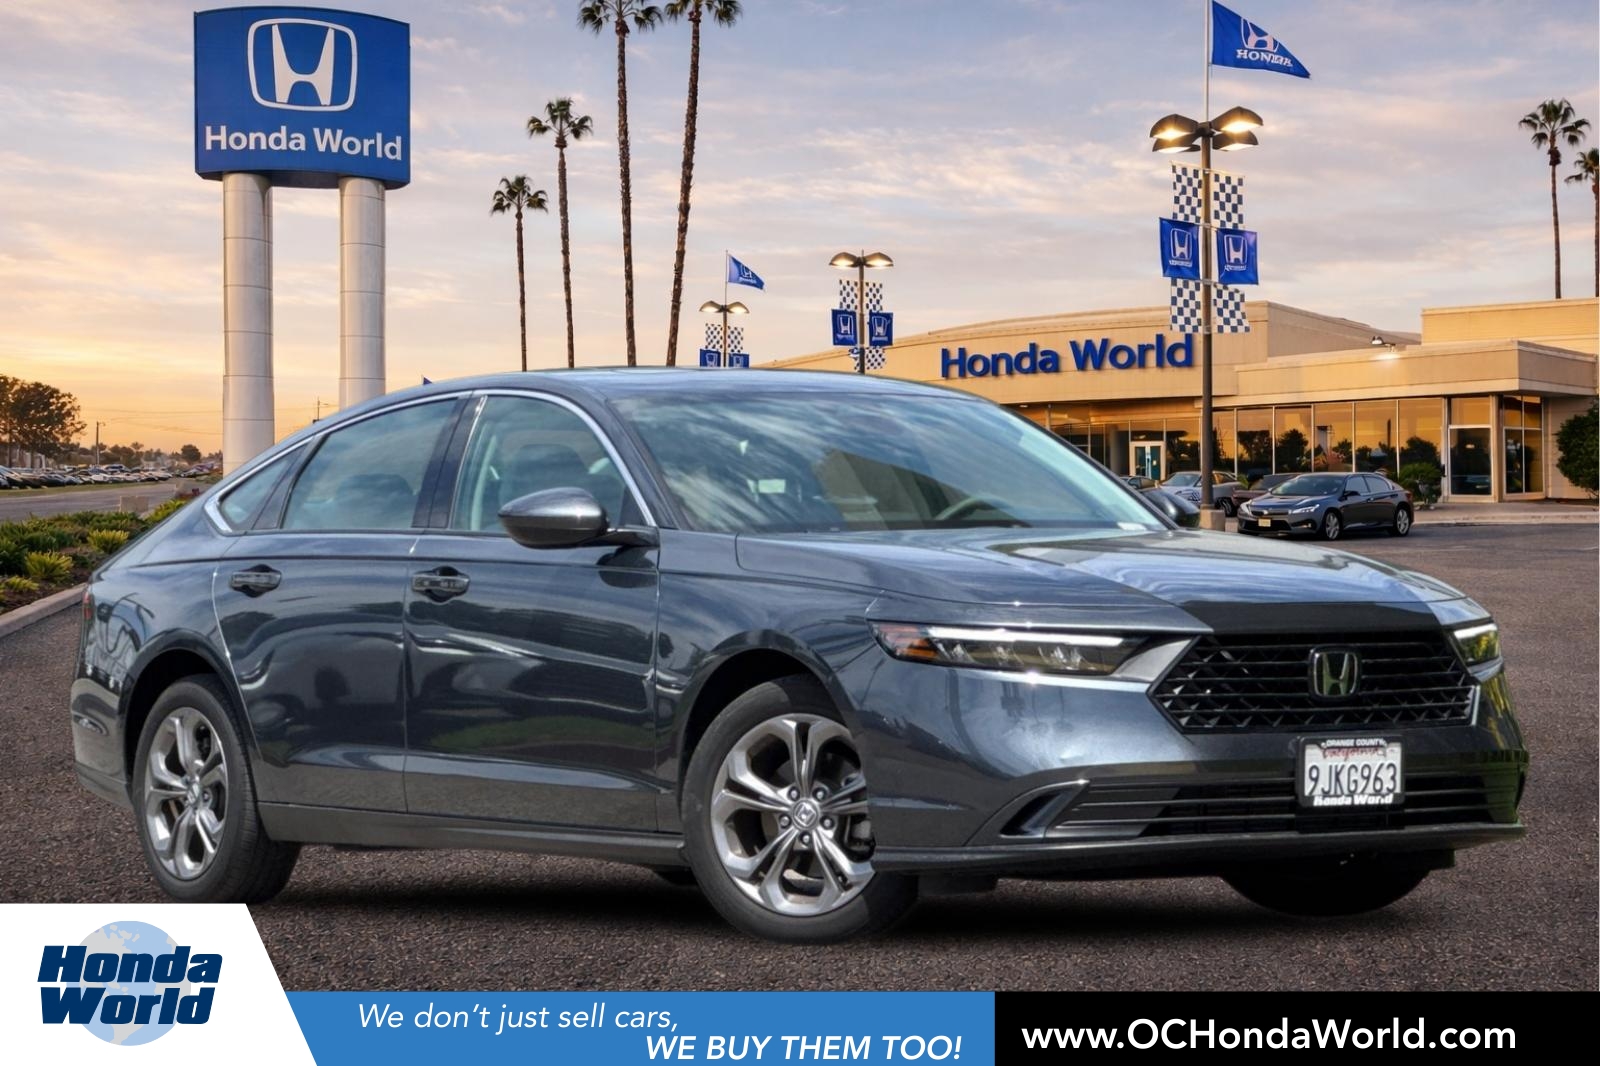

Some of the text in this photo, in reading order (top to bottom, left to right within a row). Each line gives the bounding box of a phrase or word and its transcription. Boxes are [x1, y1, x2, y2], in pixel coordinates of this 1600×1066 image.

[205, 125, 402, 161] Honda World
[941, 333, 1194, 377] Honda World
[1308, 762, 1397, 796] 9JKG963
